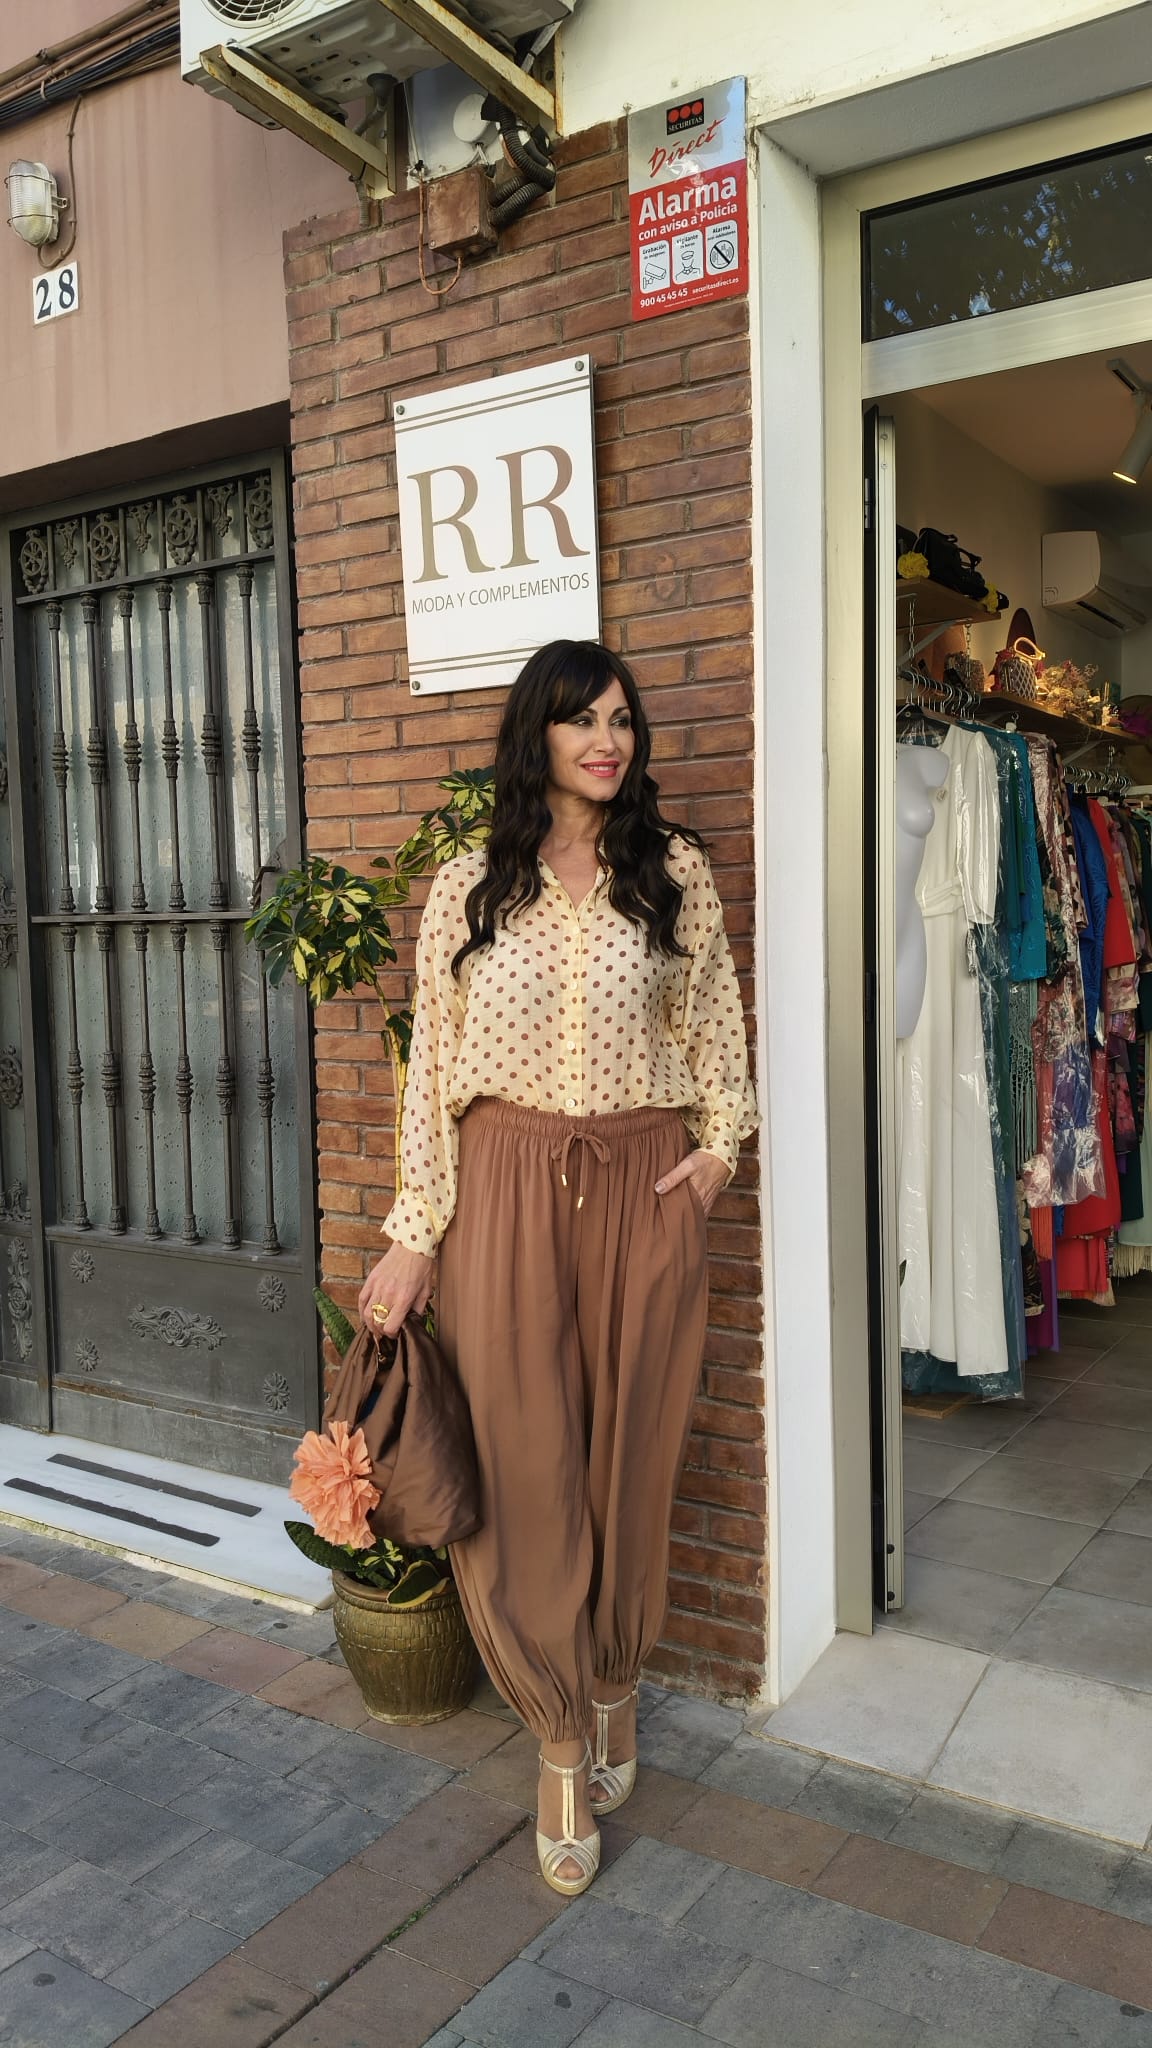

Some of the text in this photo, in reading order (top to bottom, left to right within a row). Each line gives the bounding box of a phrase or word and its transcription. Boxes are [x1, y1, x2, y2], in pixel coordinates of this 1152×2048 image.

[668, 115, 703, 131] SECURITAS
[648, 117, 727, 178] Direct
[638, 175, 738, 226] Alarma
[638, 202, 738, 241] con aviso a Policía
[36, 268, 75, 320] 28
[640, 296, 655, 308] 900
[656, 293, 666, 303] 45
[667, 290, 677, 300] 45
[678, 287, 688, 297] 45
[406, 444, 591, 584] RR
[411, 572, 590, 615] MODA Y COMPLEMENTOS
